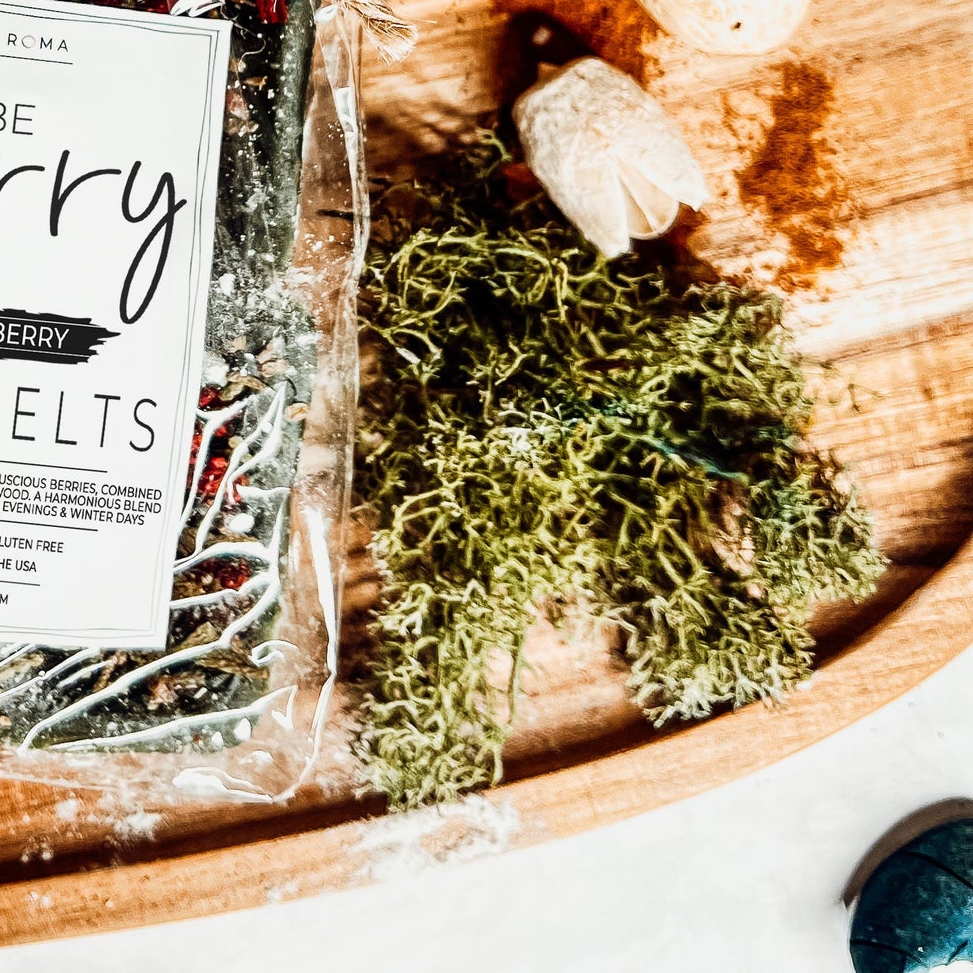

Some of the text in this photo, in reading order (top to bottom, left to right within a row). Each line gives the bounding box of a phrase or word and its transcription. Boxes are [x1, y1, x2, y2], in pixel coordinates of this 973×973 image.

[8, 34, 69, 52] ROMA
[50, 479, 98, 495] BERRIES,
[101, 484, 162, 501] COMBINED
[33, 490, 42, 502] A
[45, 492, 121, 510] HARMONIOUS
[124, 500, 162, 514] BLEND
[2, 501, 58, 517] EVENINGS
[59, 507, 67, 518] &
[70, 508, 114, 523] WINTER
[116, 513, 145, 526] DAYS
[36, 540, 64, 553] FREE
[15, 560, 37, 573] USA
